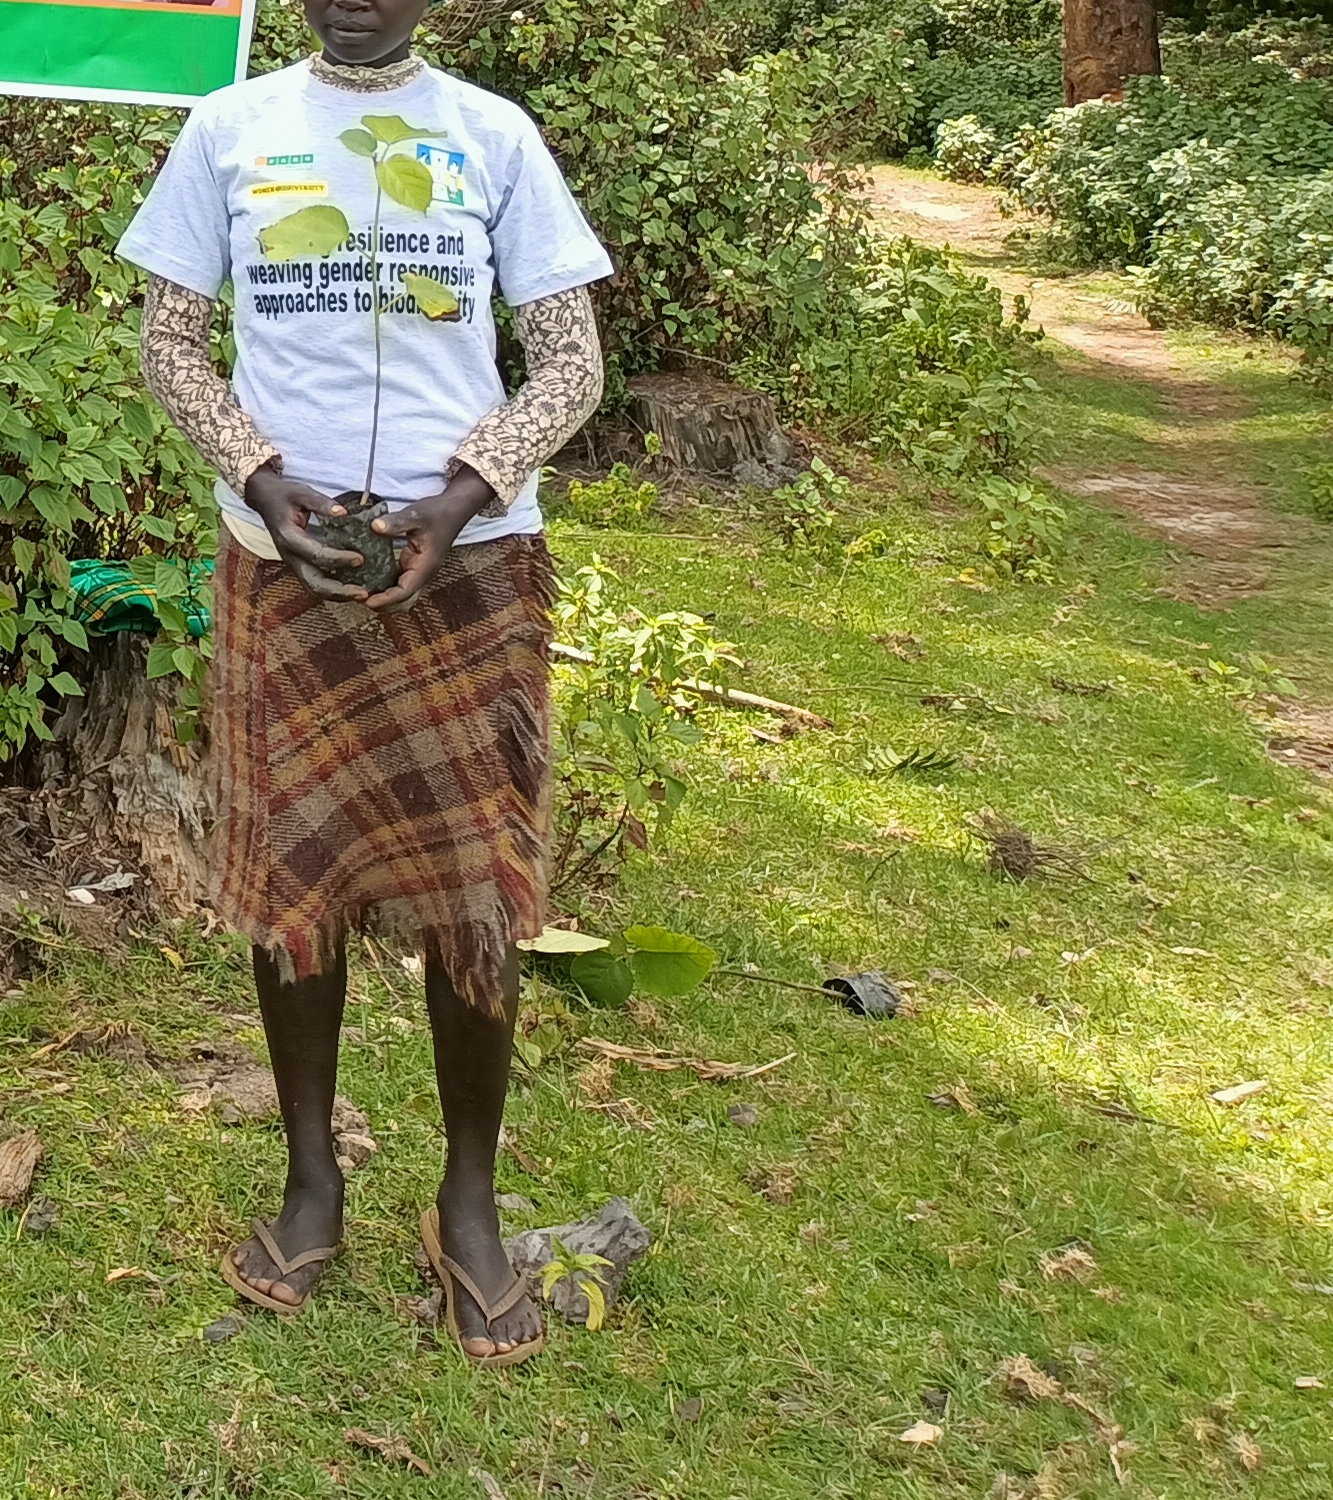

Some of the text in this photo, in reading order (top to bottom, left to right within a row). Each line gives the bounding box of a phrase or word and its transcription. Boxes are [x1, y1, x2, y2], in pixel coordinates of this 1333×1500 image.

[338, 225, 464, 256] resiience and
[246, 258, 313, 289] weaving
[319, 256, 384, 289] gender
[253, 286, 348, 321] approaches
[354, 286, 373, 312] to
